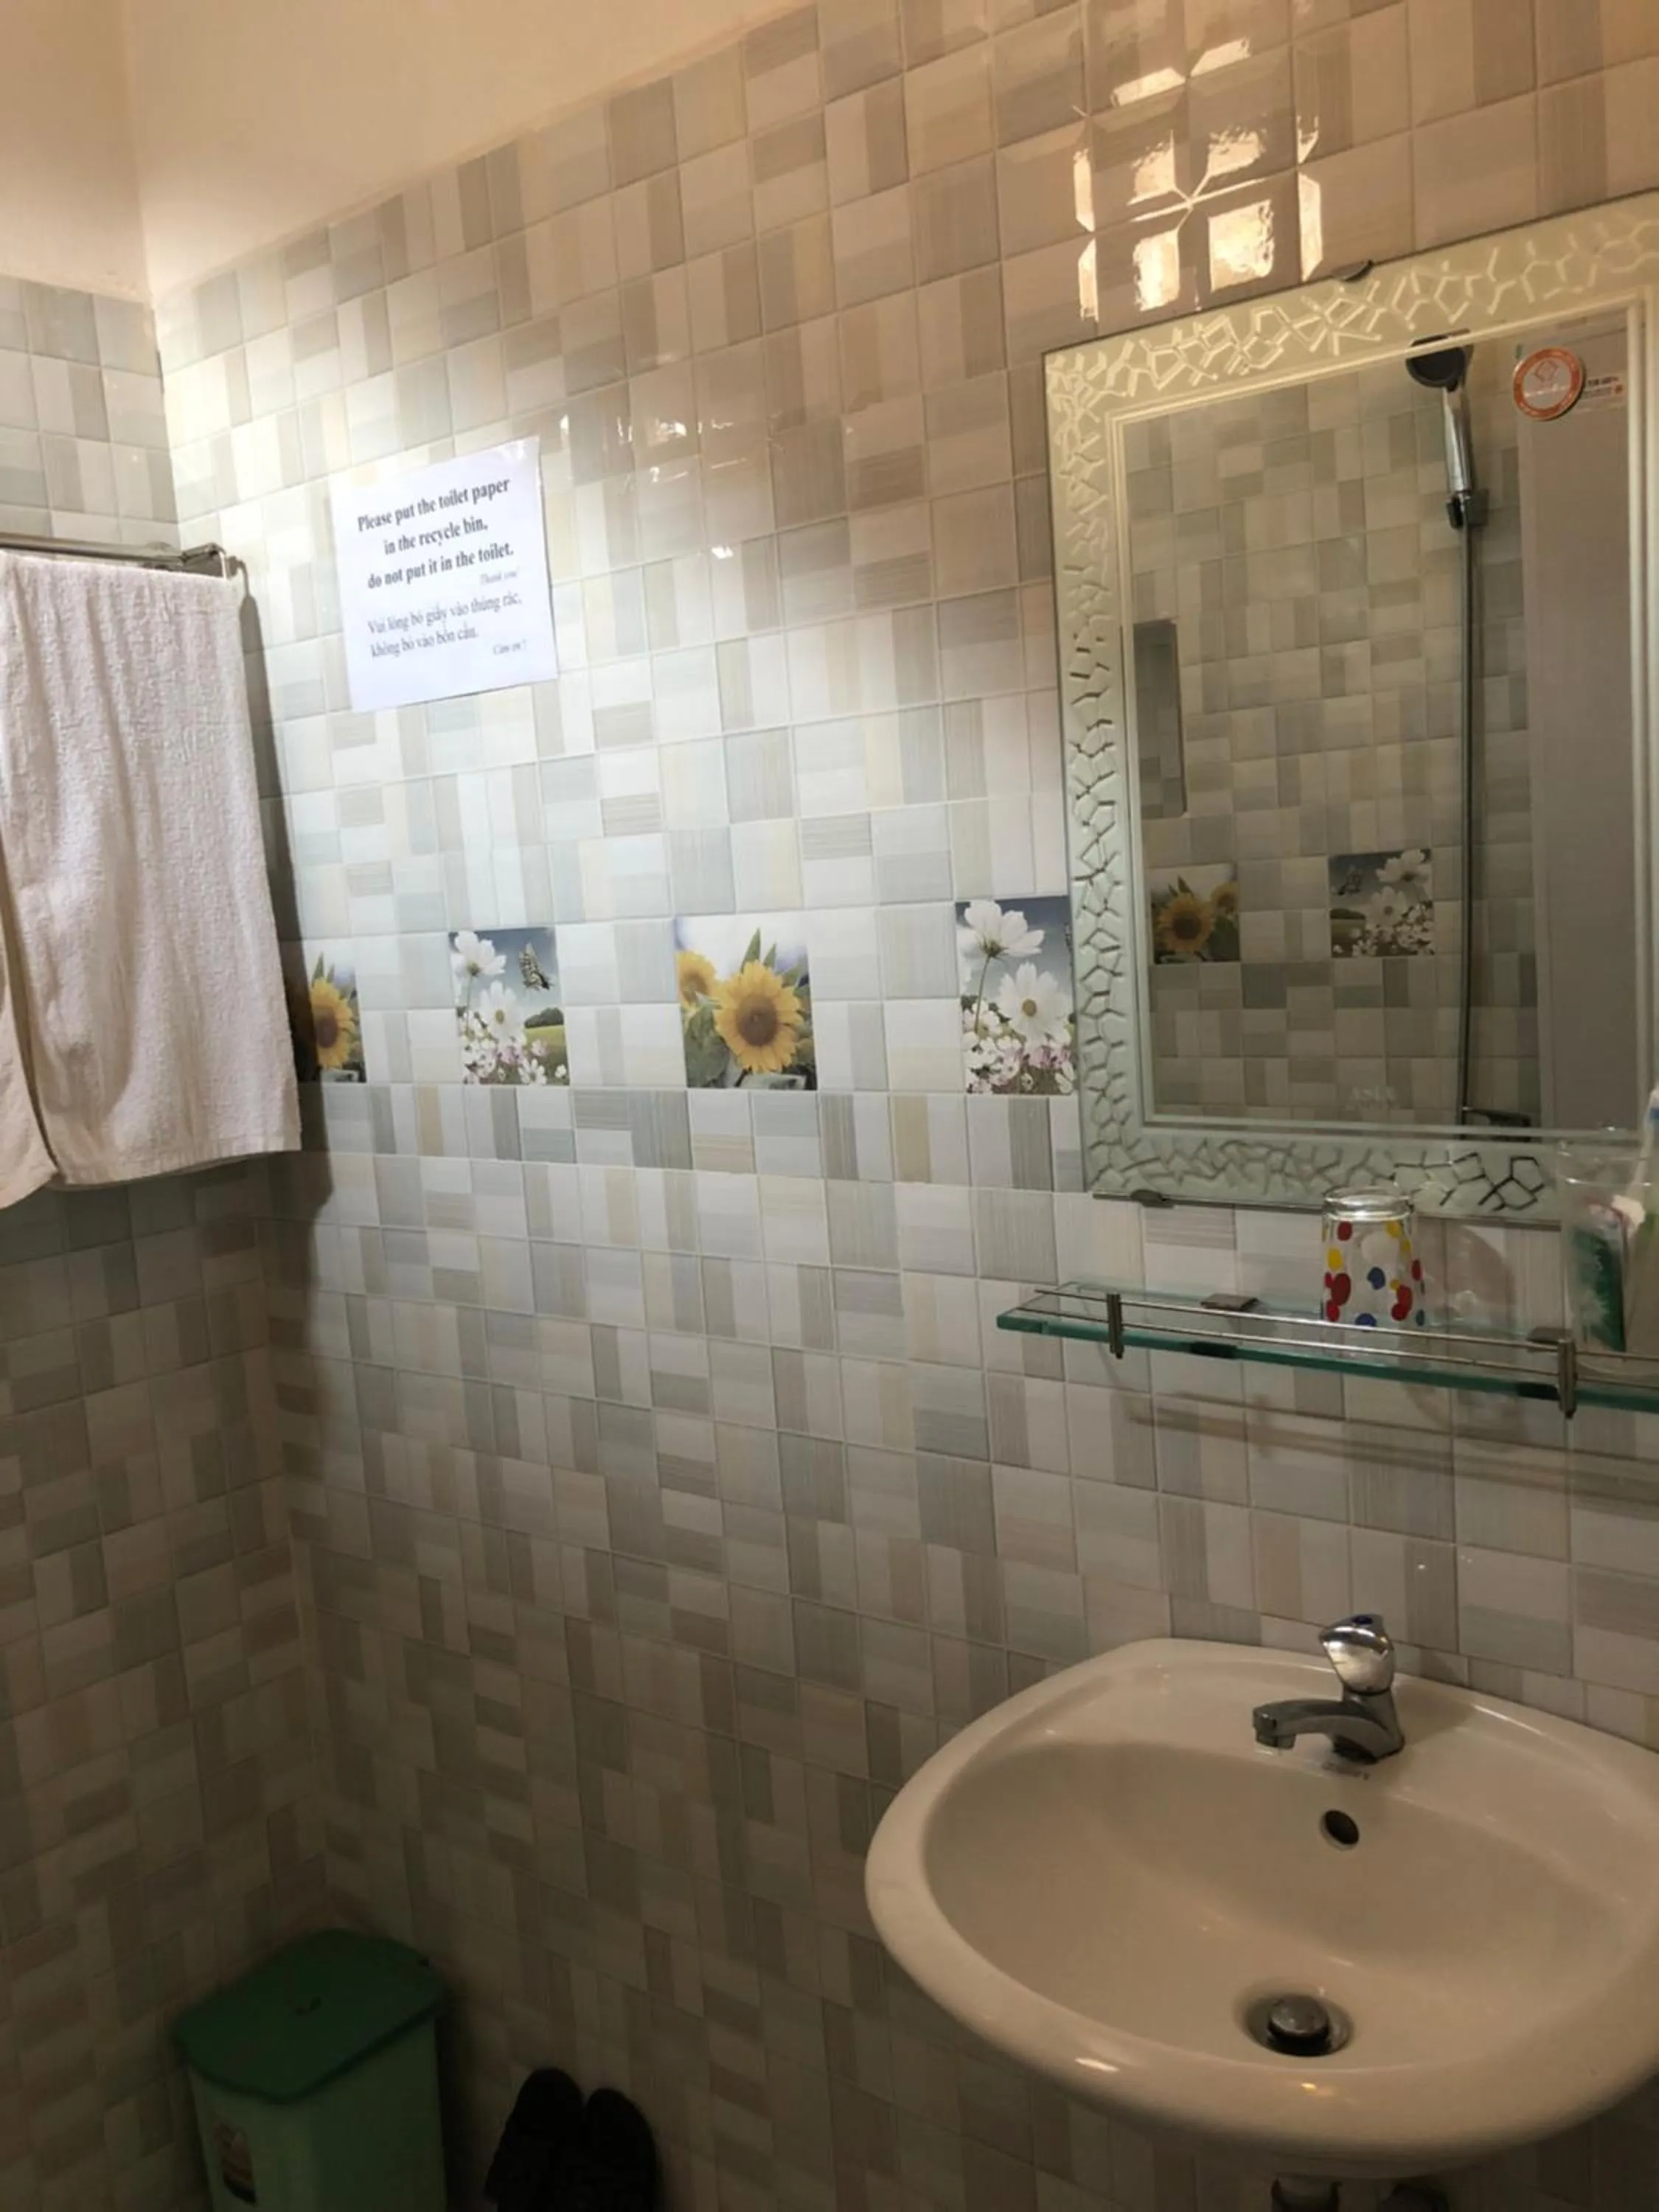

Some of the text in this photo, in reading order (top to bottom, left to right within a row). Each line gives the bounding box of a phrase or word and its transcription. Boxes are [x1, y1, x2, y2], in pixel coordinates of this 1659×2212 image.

[358, 479, 510, 531] Please put the toilet paper
[383, 540, 396, 554] in
[398, 535, 416, 551] the
[420, 522, 460, 546] recycle
[368, 543, 514, 589] do not put it in the toilet.
